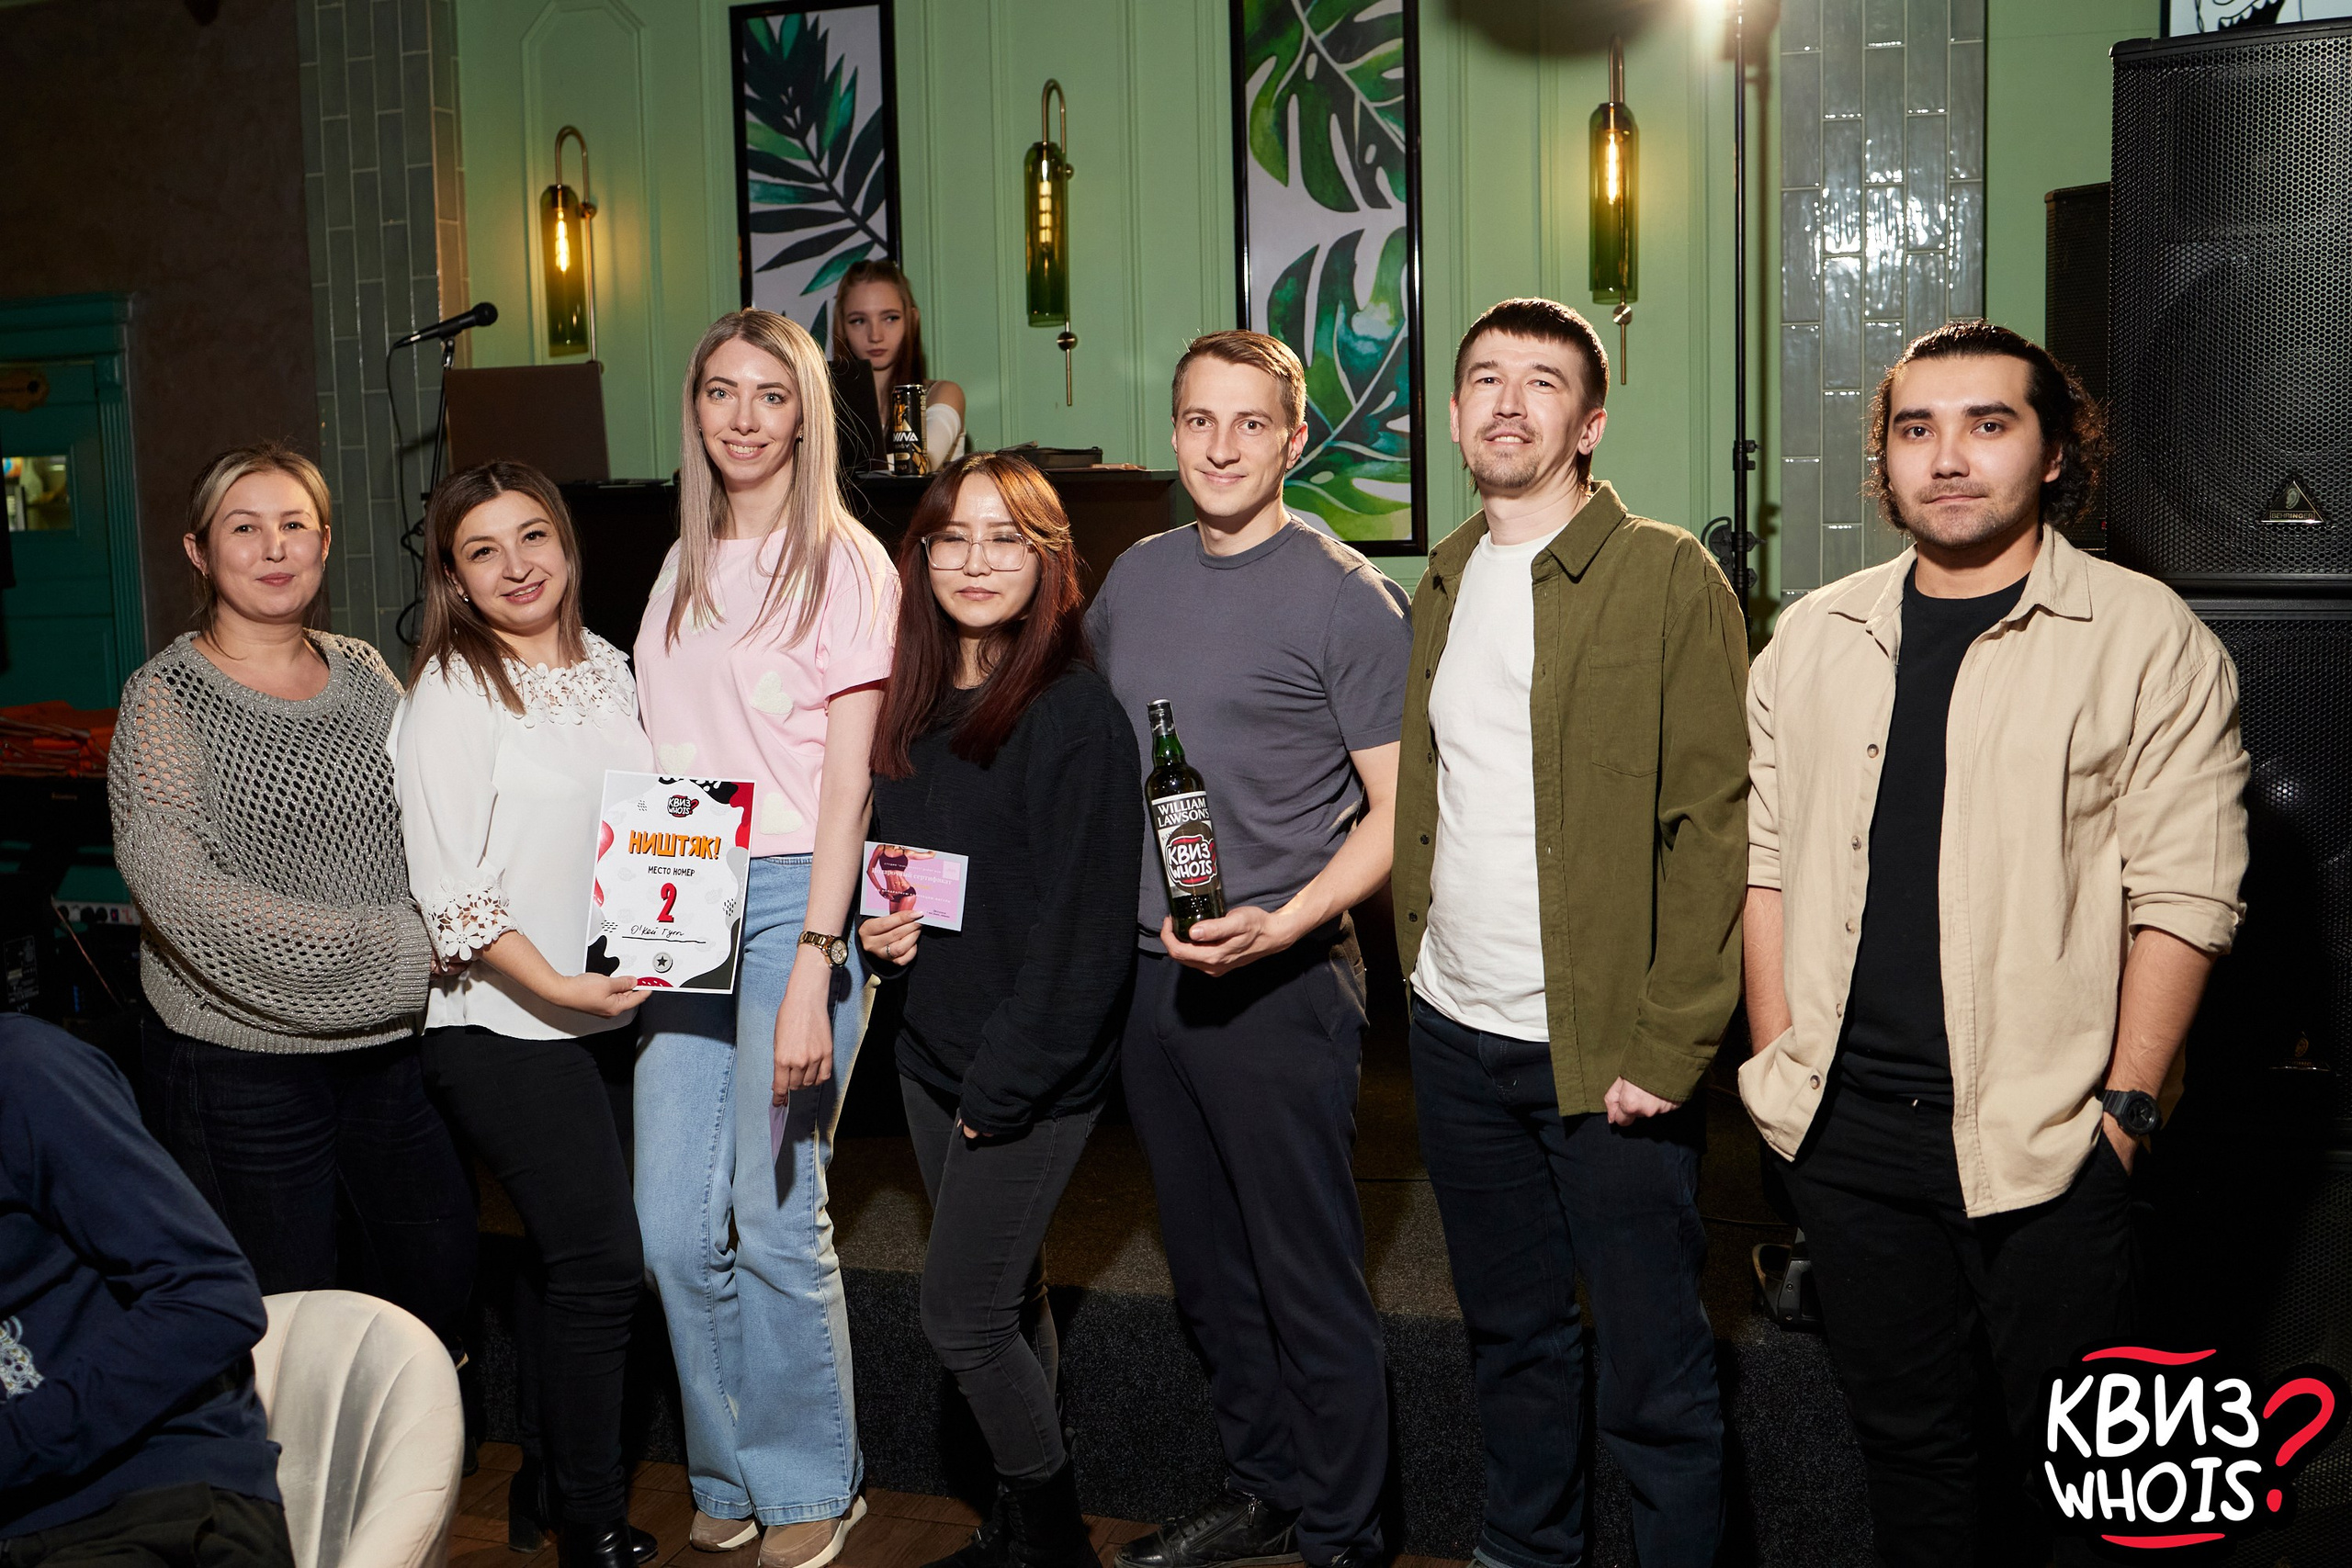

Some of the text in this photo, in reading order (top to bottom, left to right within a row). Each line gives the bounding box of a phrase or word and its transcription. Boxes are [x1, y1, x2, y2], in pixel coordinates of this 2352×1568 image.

[667, 806, 691, 815] WHOIS
[669, 797, 691, 807] КВИЗ
[1158, 797, 1206, 816] WILLIAM
[1158, 808, 1210, 828] LAWSON'S
[628, 829, 722, 860] НИШТЯК!
[1168, 842, 1211, 865] КВИЗ
[648, 866, 695, 877] МЕСТО НОМЕР
[1169, 860, 1213, 879] WHOIS
[656, 883, 677, 923] 2
